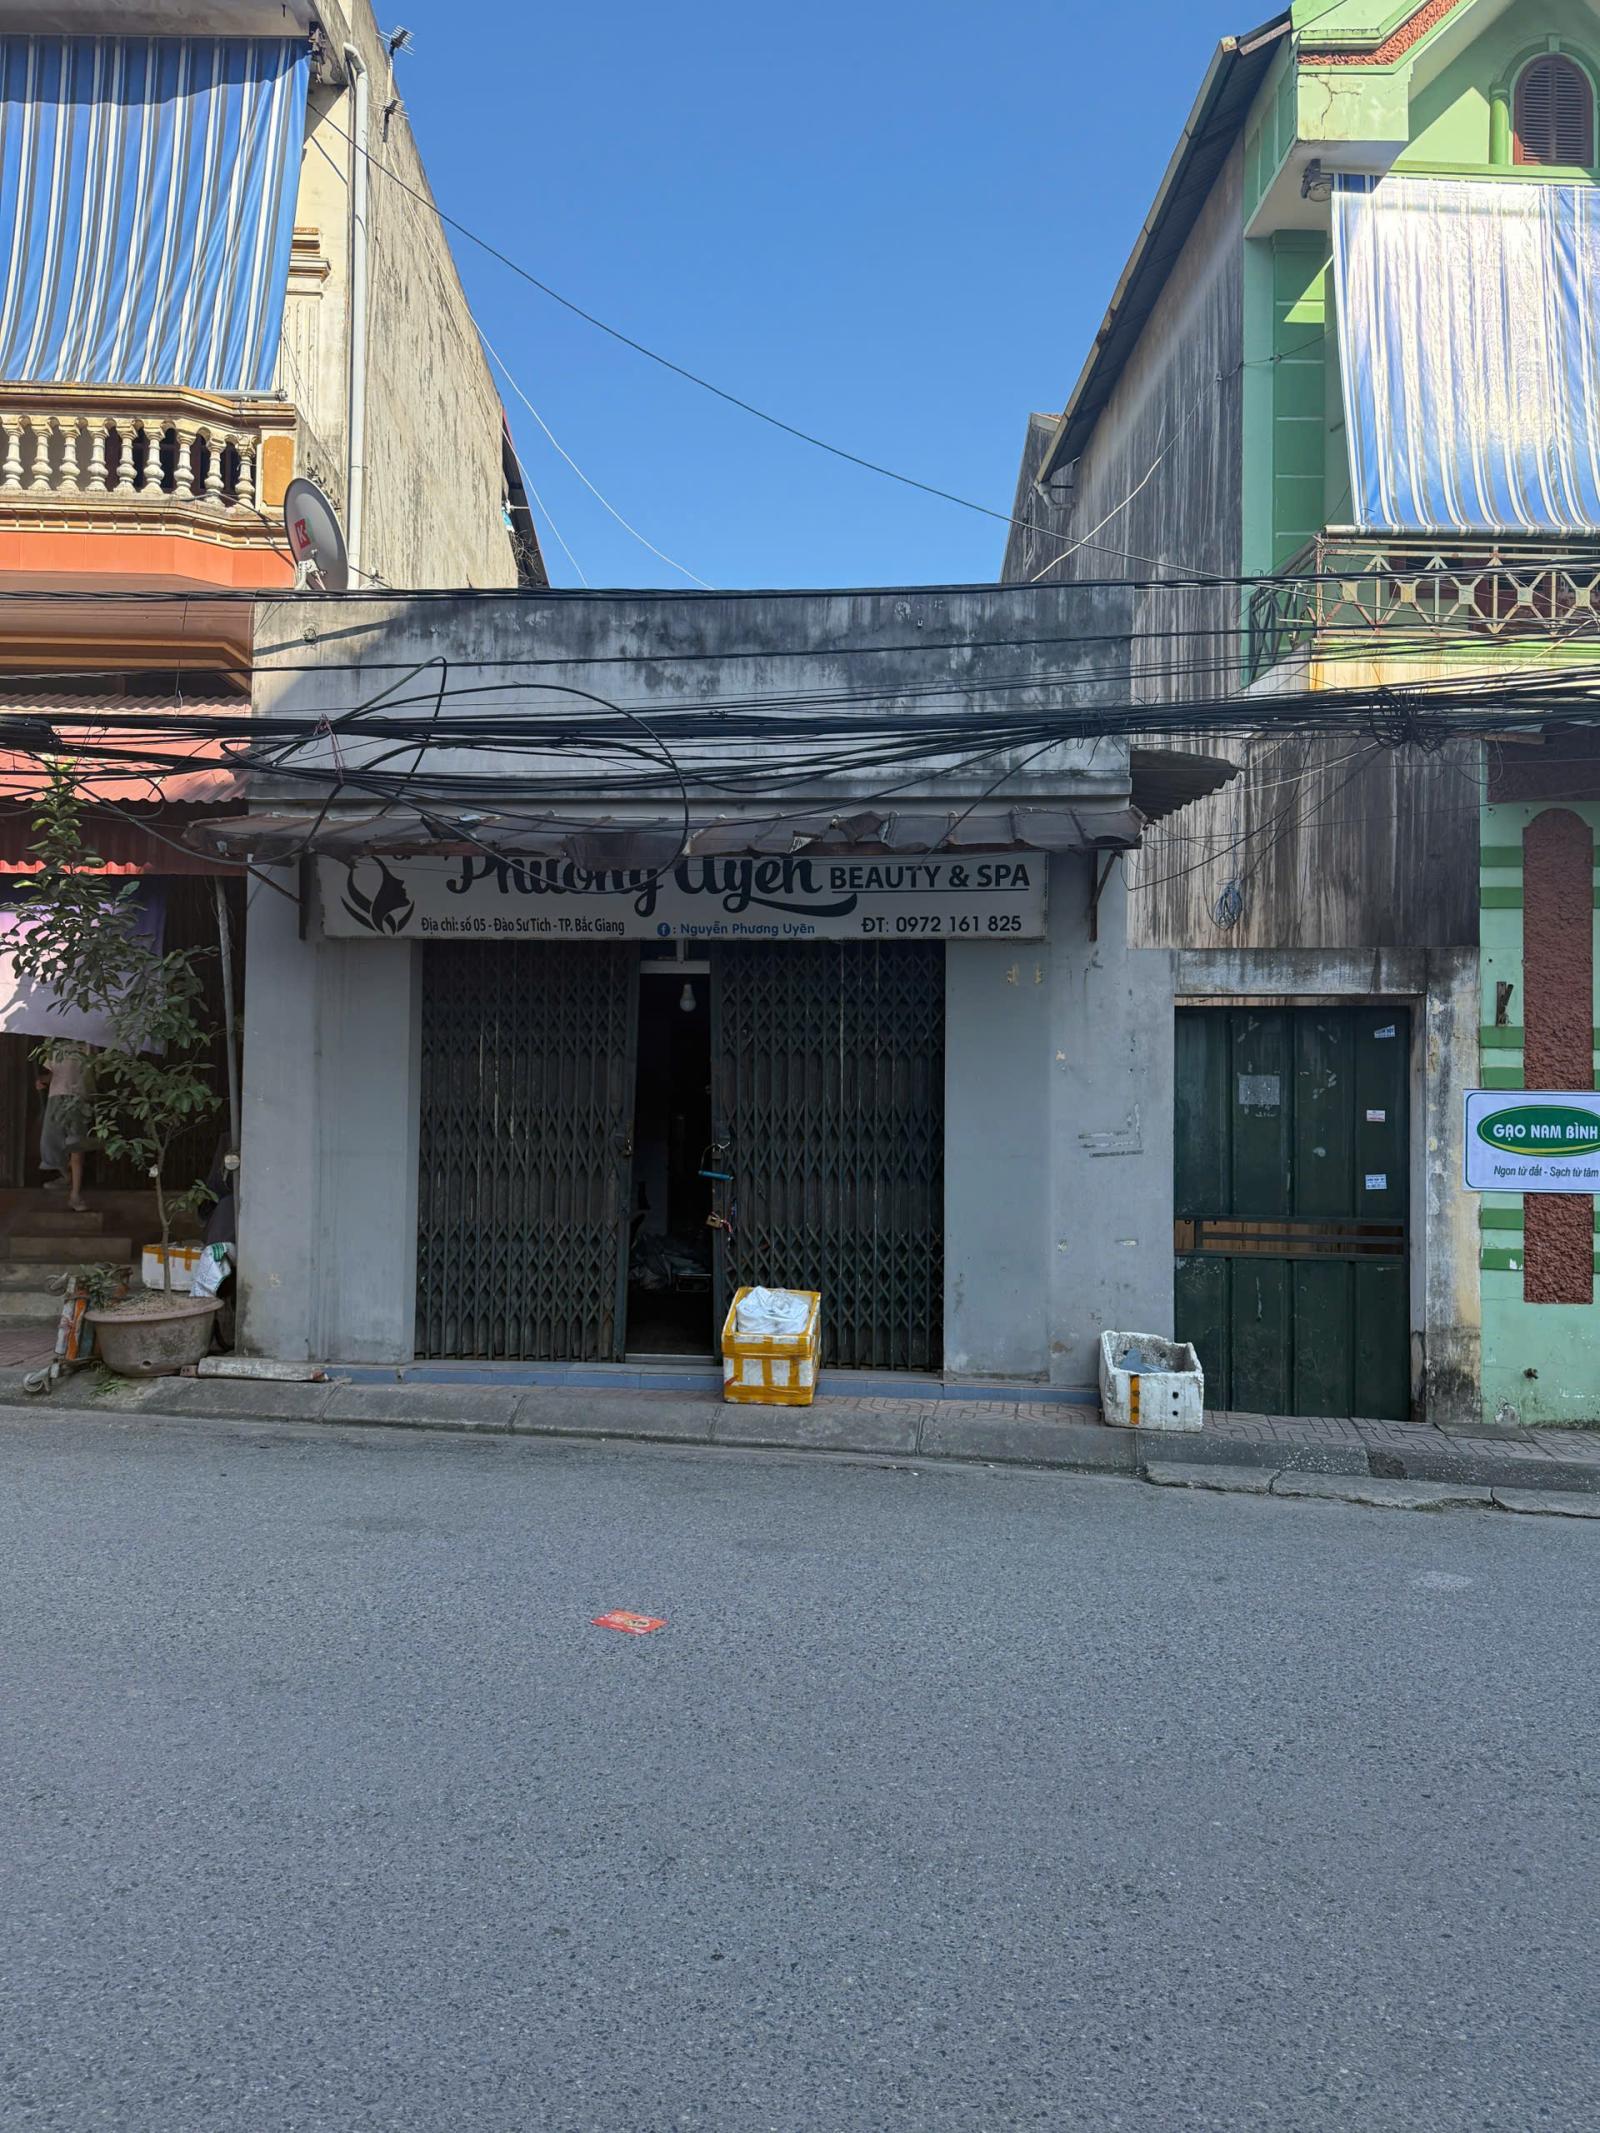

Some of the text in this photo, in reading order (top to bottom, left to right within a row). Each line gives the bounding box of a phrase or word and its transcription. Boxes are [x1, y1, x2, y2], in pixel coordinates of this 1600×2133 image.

[830, 864, 1030, 890] BEAUTY & SPA
[421, 916, 439, 935] Địa
[441, 916, 459, 931] chỉ:
[460, 914, 472, 931] số
[473, 918, 486, 931] 05
[493, 916, 514, 931] Đào
[559, 918, 573, 931] TP.
[575, 915, 592, 932] Bắc
[594, 917, 625, 935] Giang
[680, 920, 728, 937] Nguyễn
[732, 923, 779, 937] Phương
[783, 922, 816, 937] Uyên
[861, 915, 1022, 933] ĐT: 0972 161 825
[1492, 1121, 1599, 1141] GẠO NAM BÌNH
[1493, 1165, 1516, 1178] Ngon
[1529, 1163, 1542, 1176] đất
[1549, 1166, 1571, 1179] Sạch
[1583, 1167, 1599, 1178] tâm
